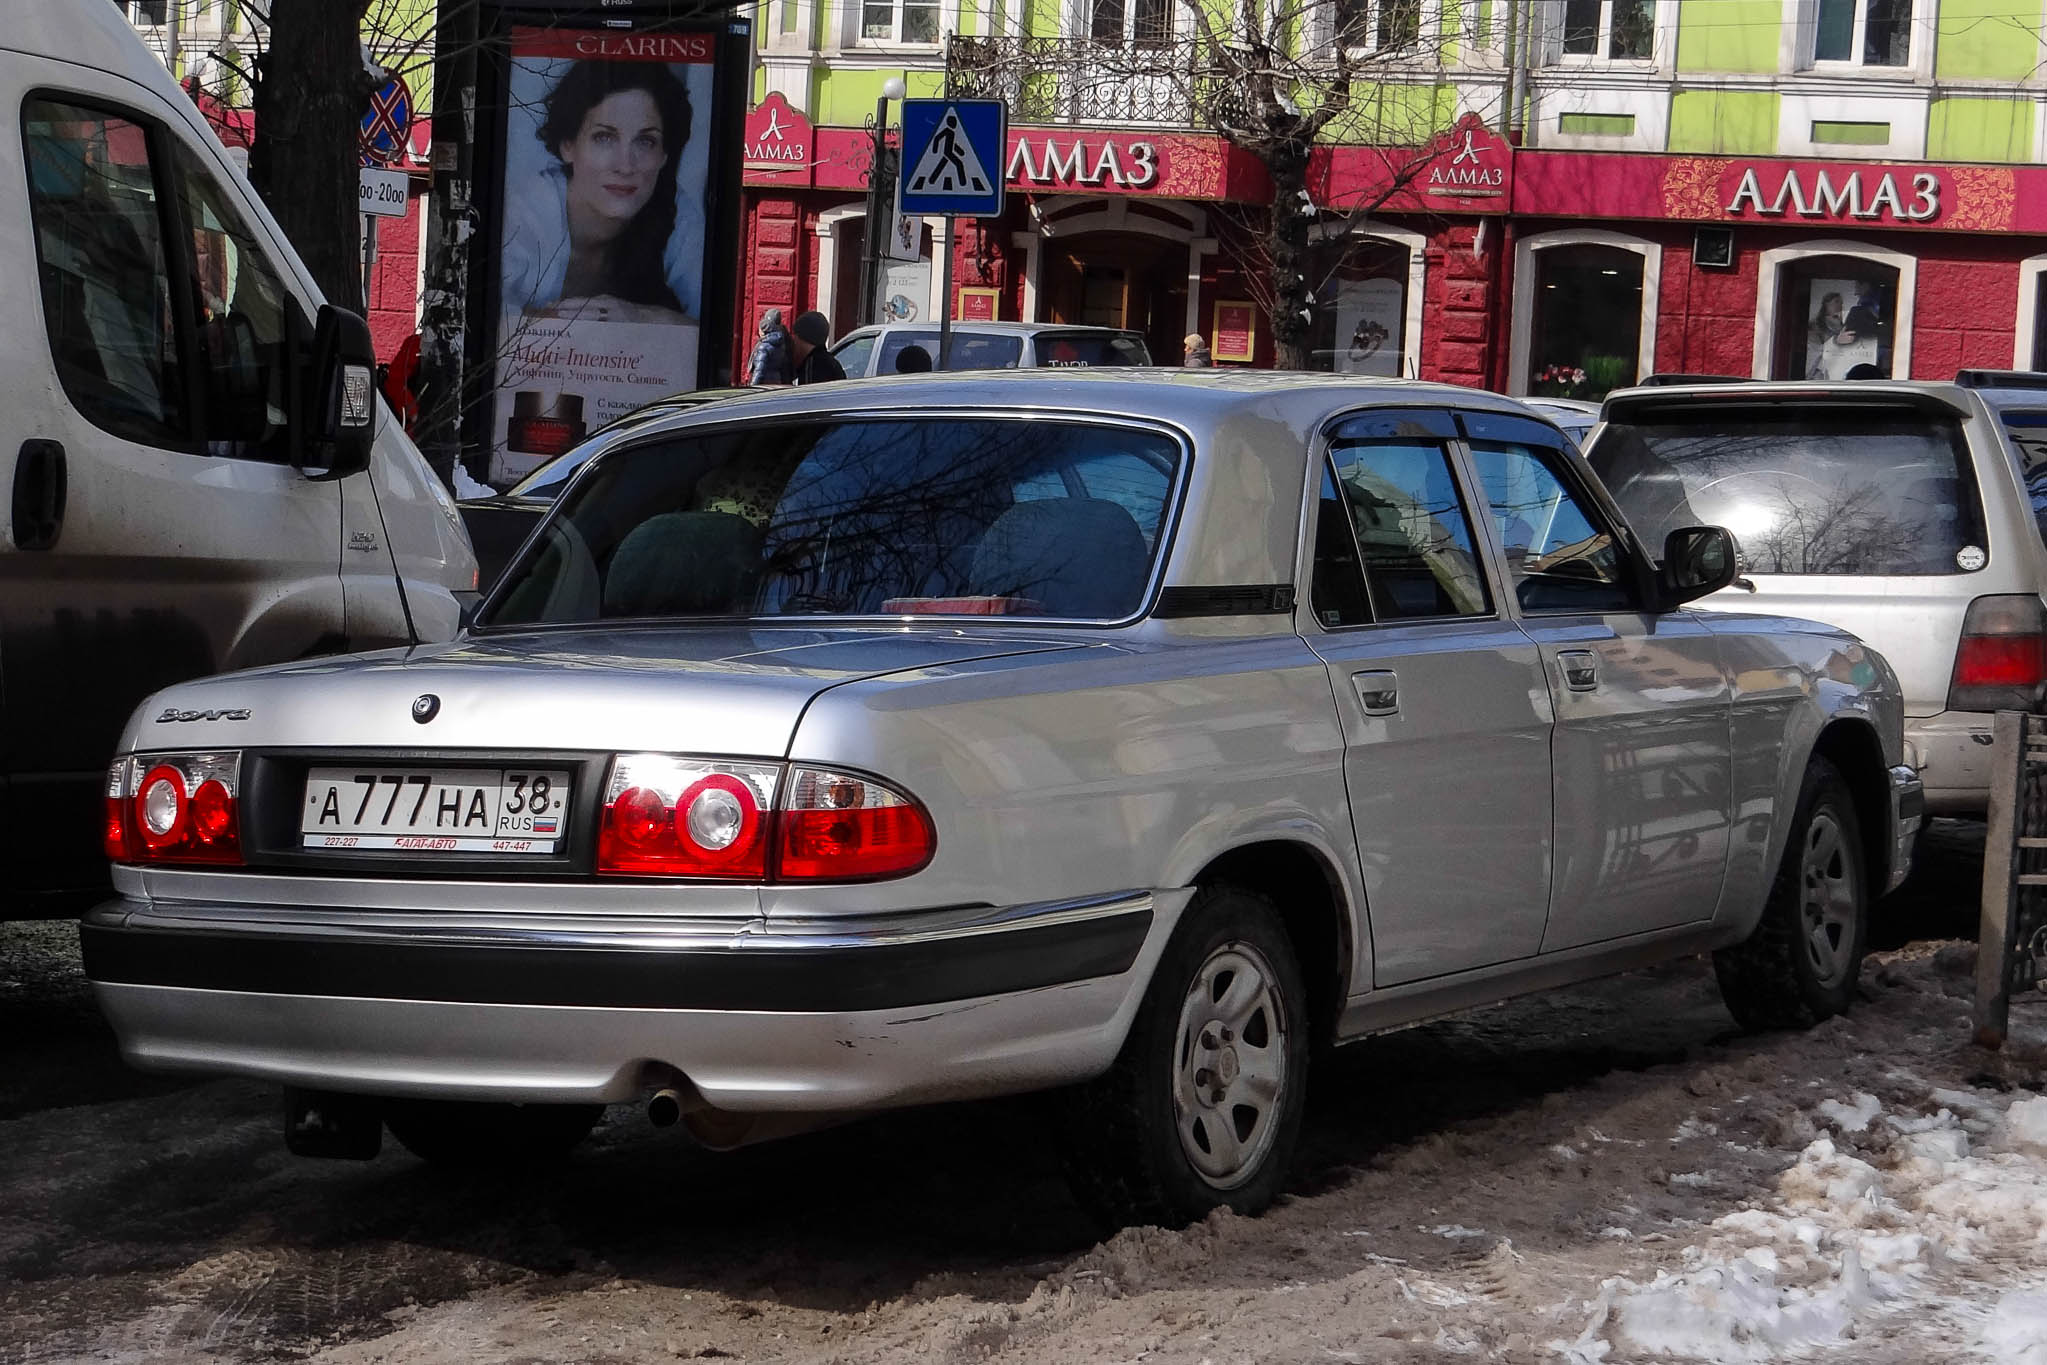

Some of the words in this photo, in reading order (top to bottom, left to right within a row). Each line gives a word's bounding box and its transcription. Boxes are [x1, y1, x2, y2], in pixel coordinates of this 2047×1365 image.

[576, 35, 706, 57] CLARINS
[1006, 137, 1159, 186] ЛМАЗ
[1429, 167, 1503, 186] АЛМАЗ
[1725, 167, 1940, 220] АЛМАЗ
[506, 775, 551, 815] 38
[500, 816, 532, 831] RUS
[324, 836, 359, 847] 227-227
[492, 841, 532, 851] 447-447
